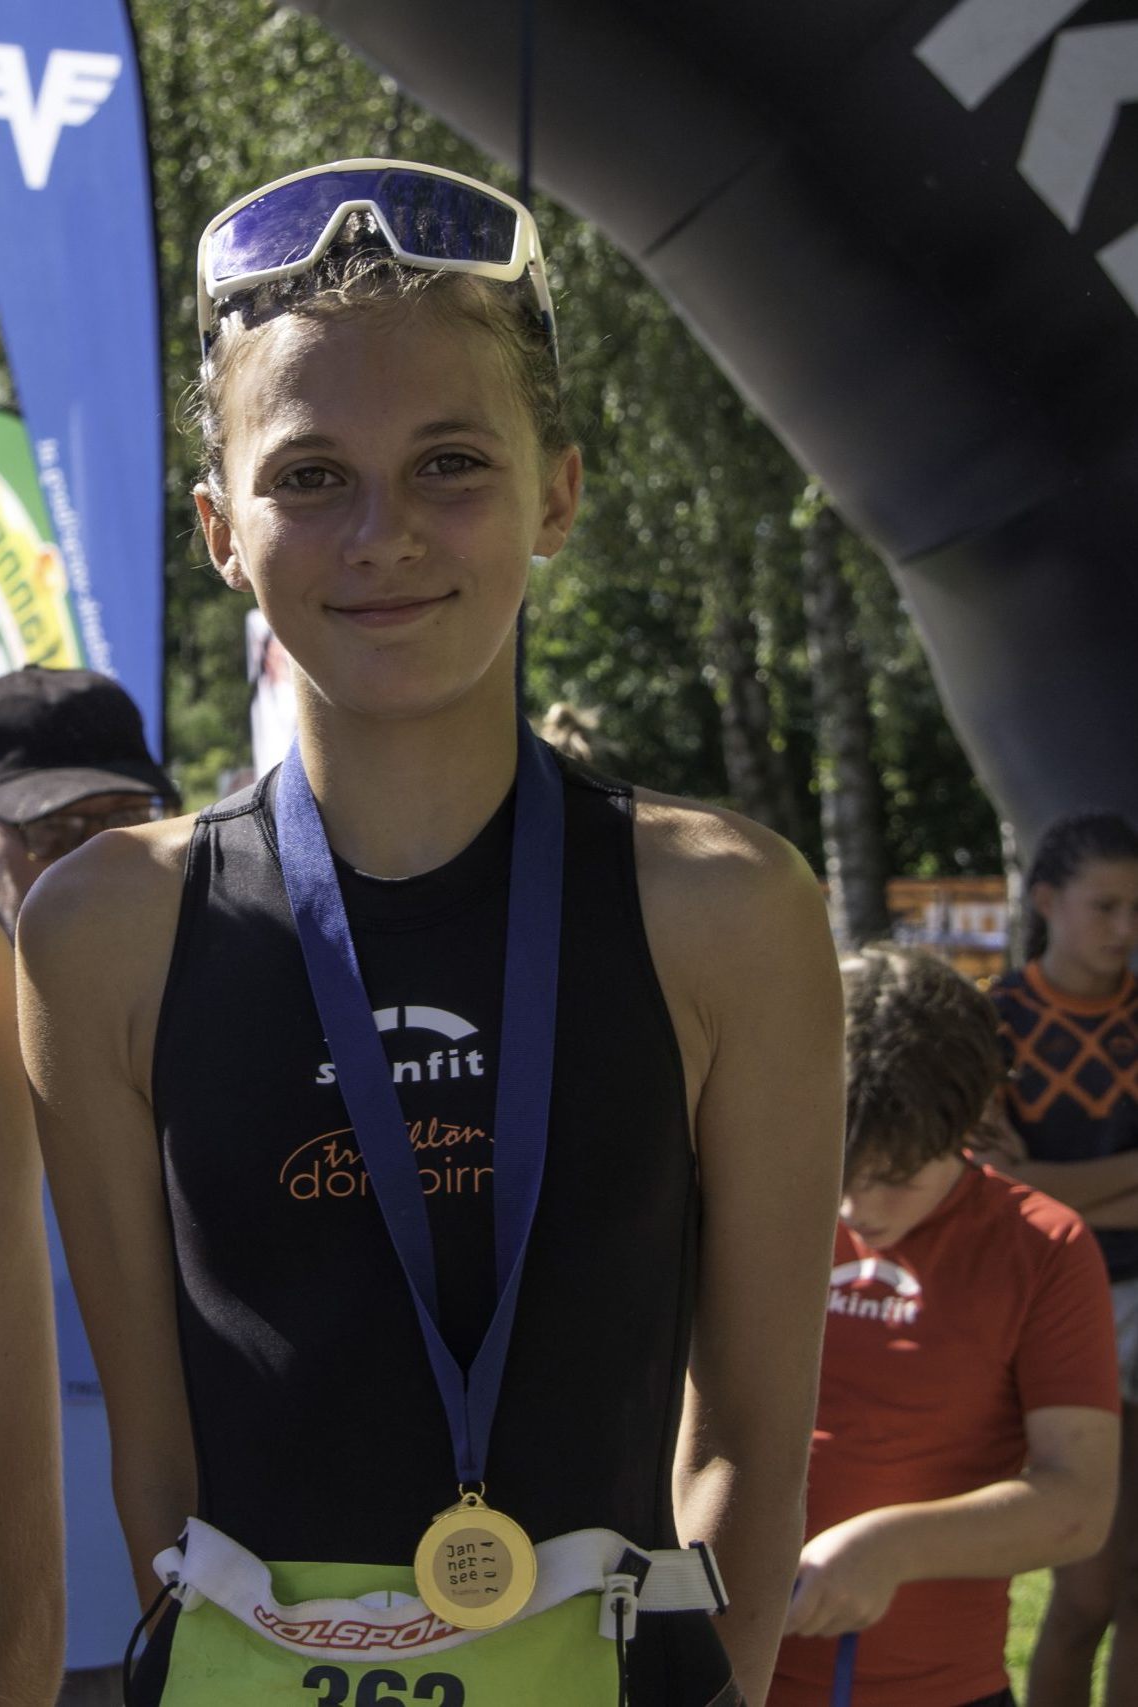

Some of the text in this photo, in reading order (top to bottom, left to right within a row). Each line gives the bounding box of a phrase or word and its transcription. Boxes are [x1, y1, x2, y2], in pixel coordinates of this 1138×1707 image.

[315, 1049, 484, 1084] snfit
[290, 1161, 495, 1200] dorirn
[828, 1289, 919, 1325] kinfit
